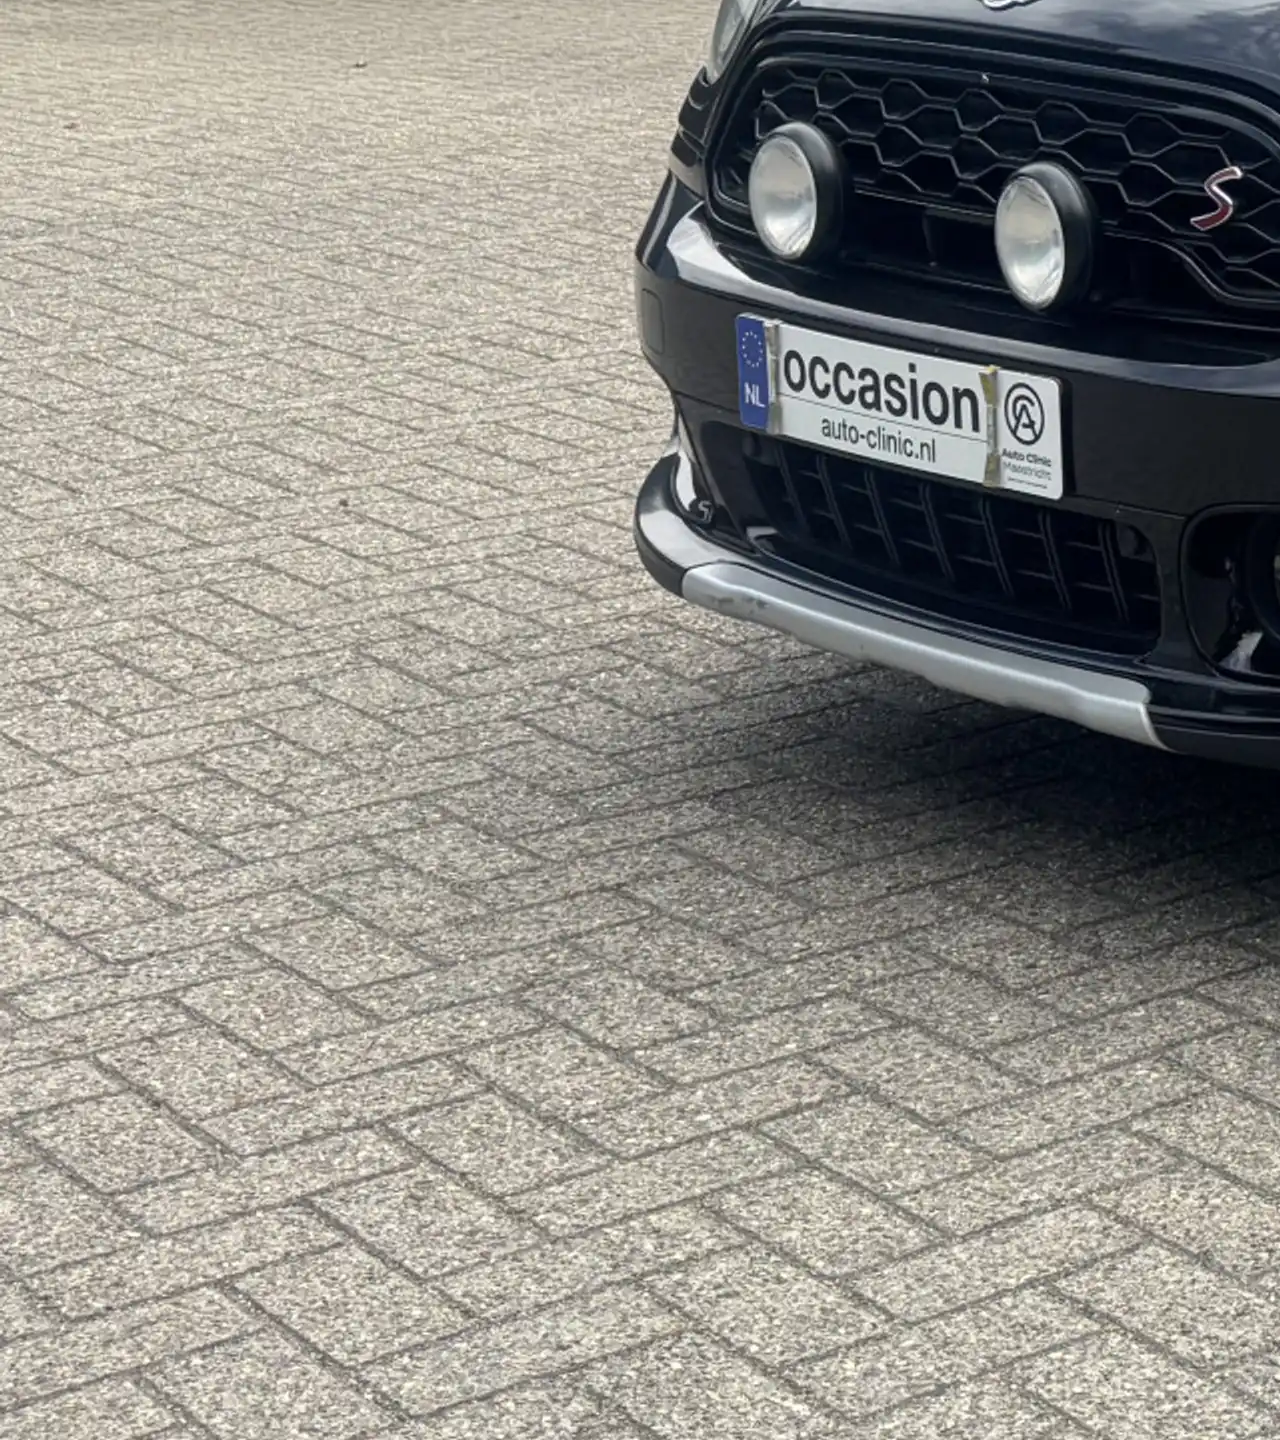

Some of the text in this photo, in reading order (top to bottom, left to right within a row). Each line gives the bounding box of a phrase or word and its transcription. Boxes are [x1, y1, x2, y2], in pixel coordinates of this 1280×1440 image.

[1190, 166, 1243, 231] S
[744, 381, 766, 408] NL
[783, 350, 980, 433] occasion
[820, 417, 936, 463] auto-clinic.nl
